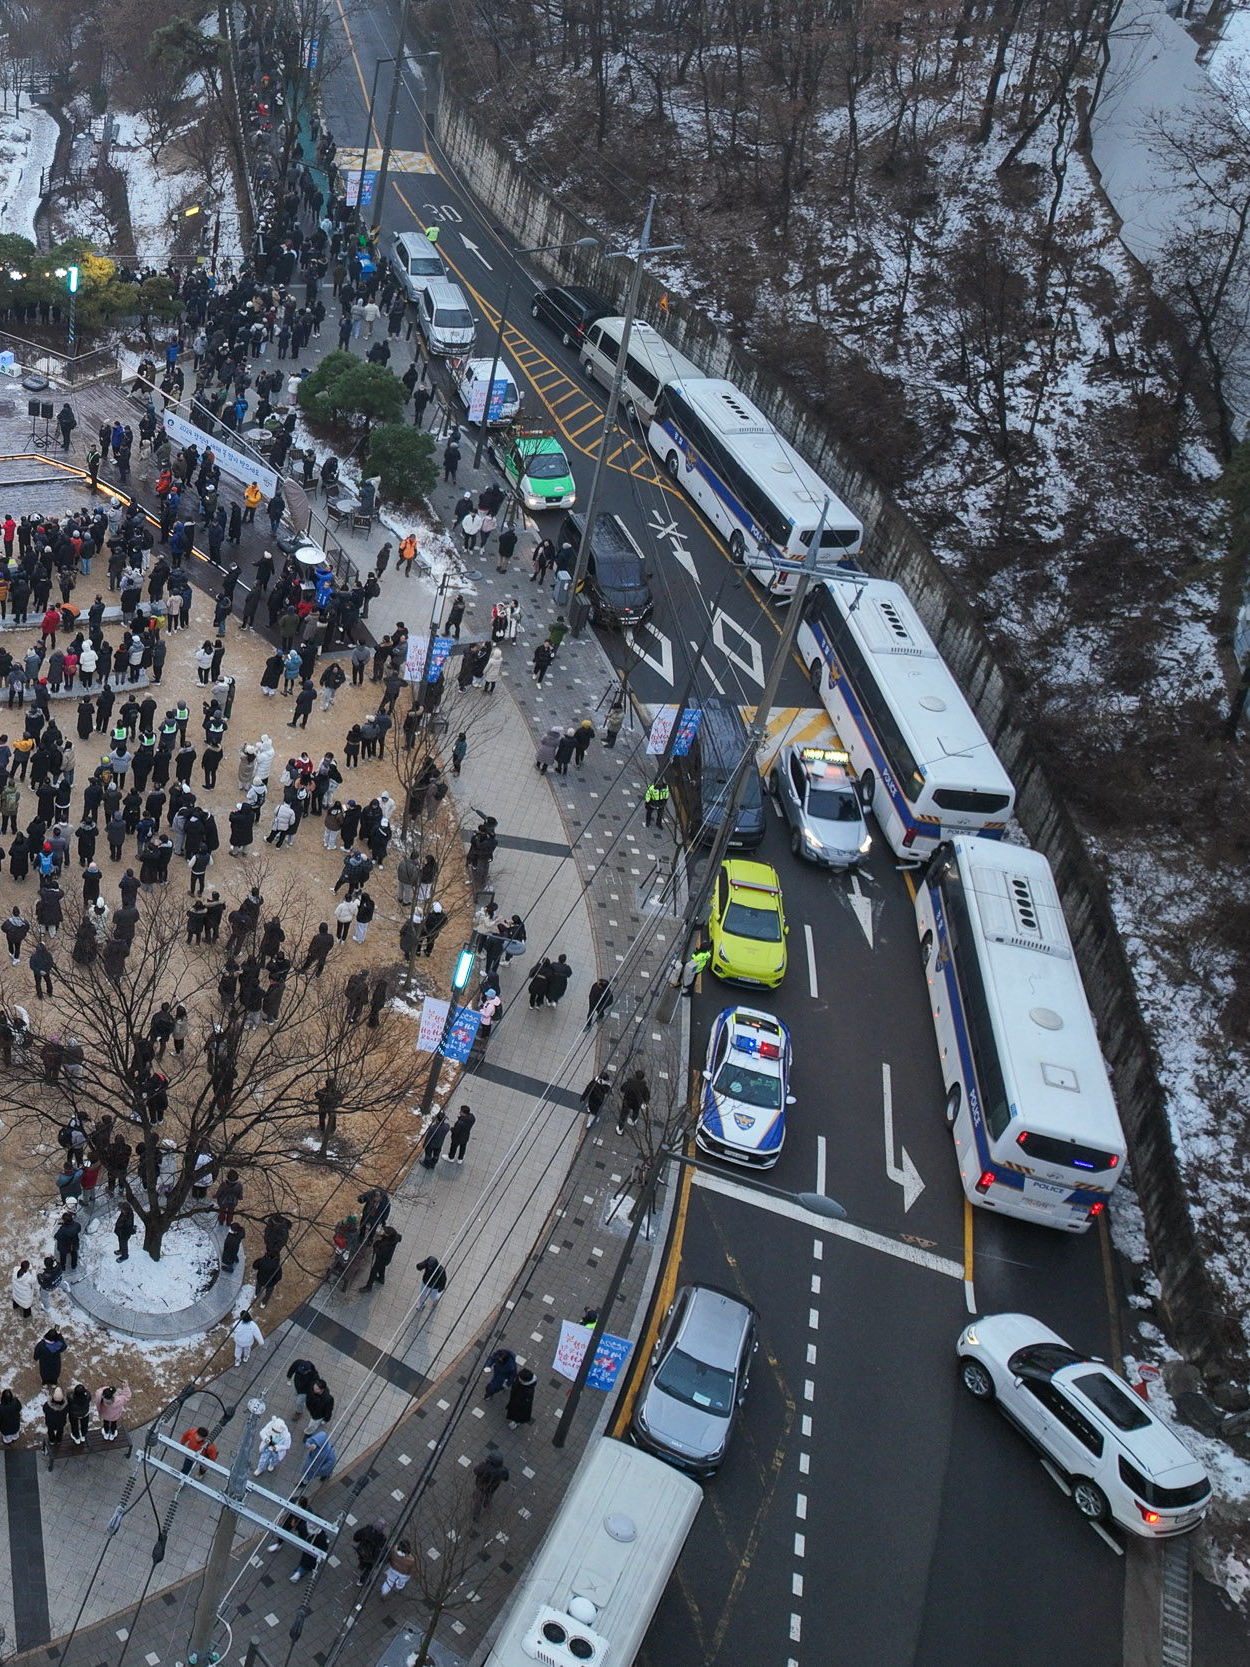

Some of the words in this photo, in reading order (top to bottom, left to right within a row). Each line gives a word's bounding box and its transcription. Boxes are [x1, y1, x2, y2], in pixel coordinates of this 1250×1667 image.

[422, 203, 462, 222] 30
[179, 423, 192, 435] 2024
[210, 443, 222, 453] 새해
[240, 459, 260, 477] 받으세요
[882, 768, 898, 798] POLICE
[969, 1088, 981, 1127] POLICE
[1033, 1181, 1065, 1194] POLICE
